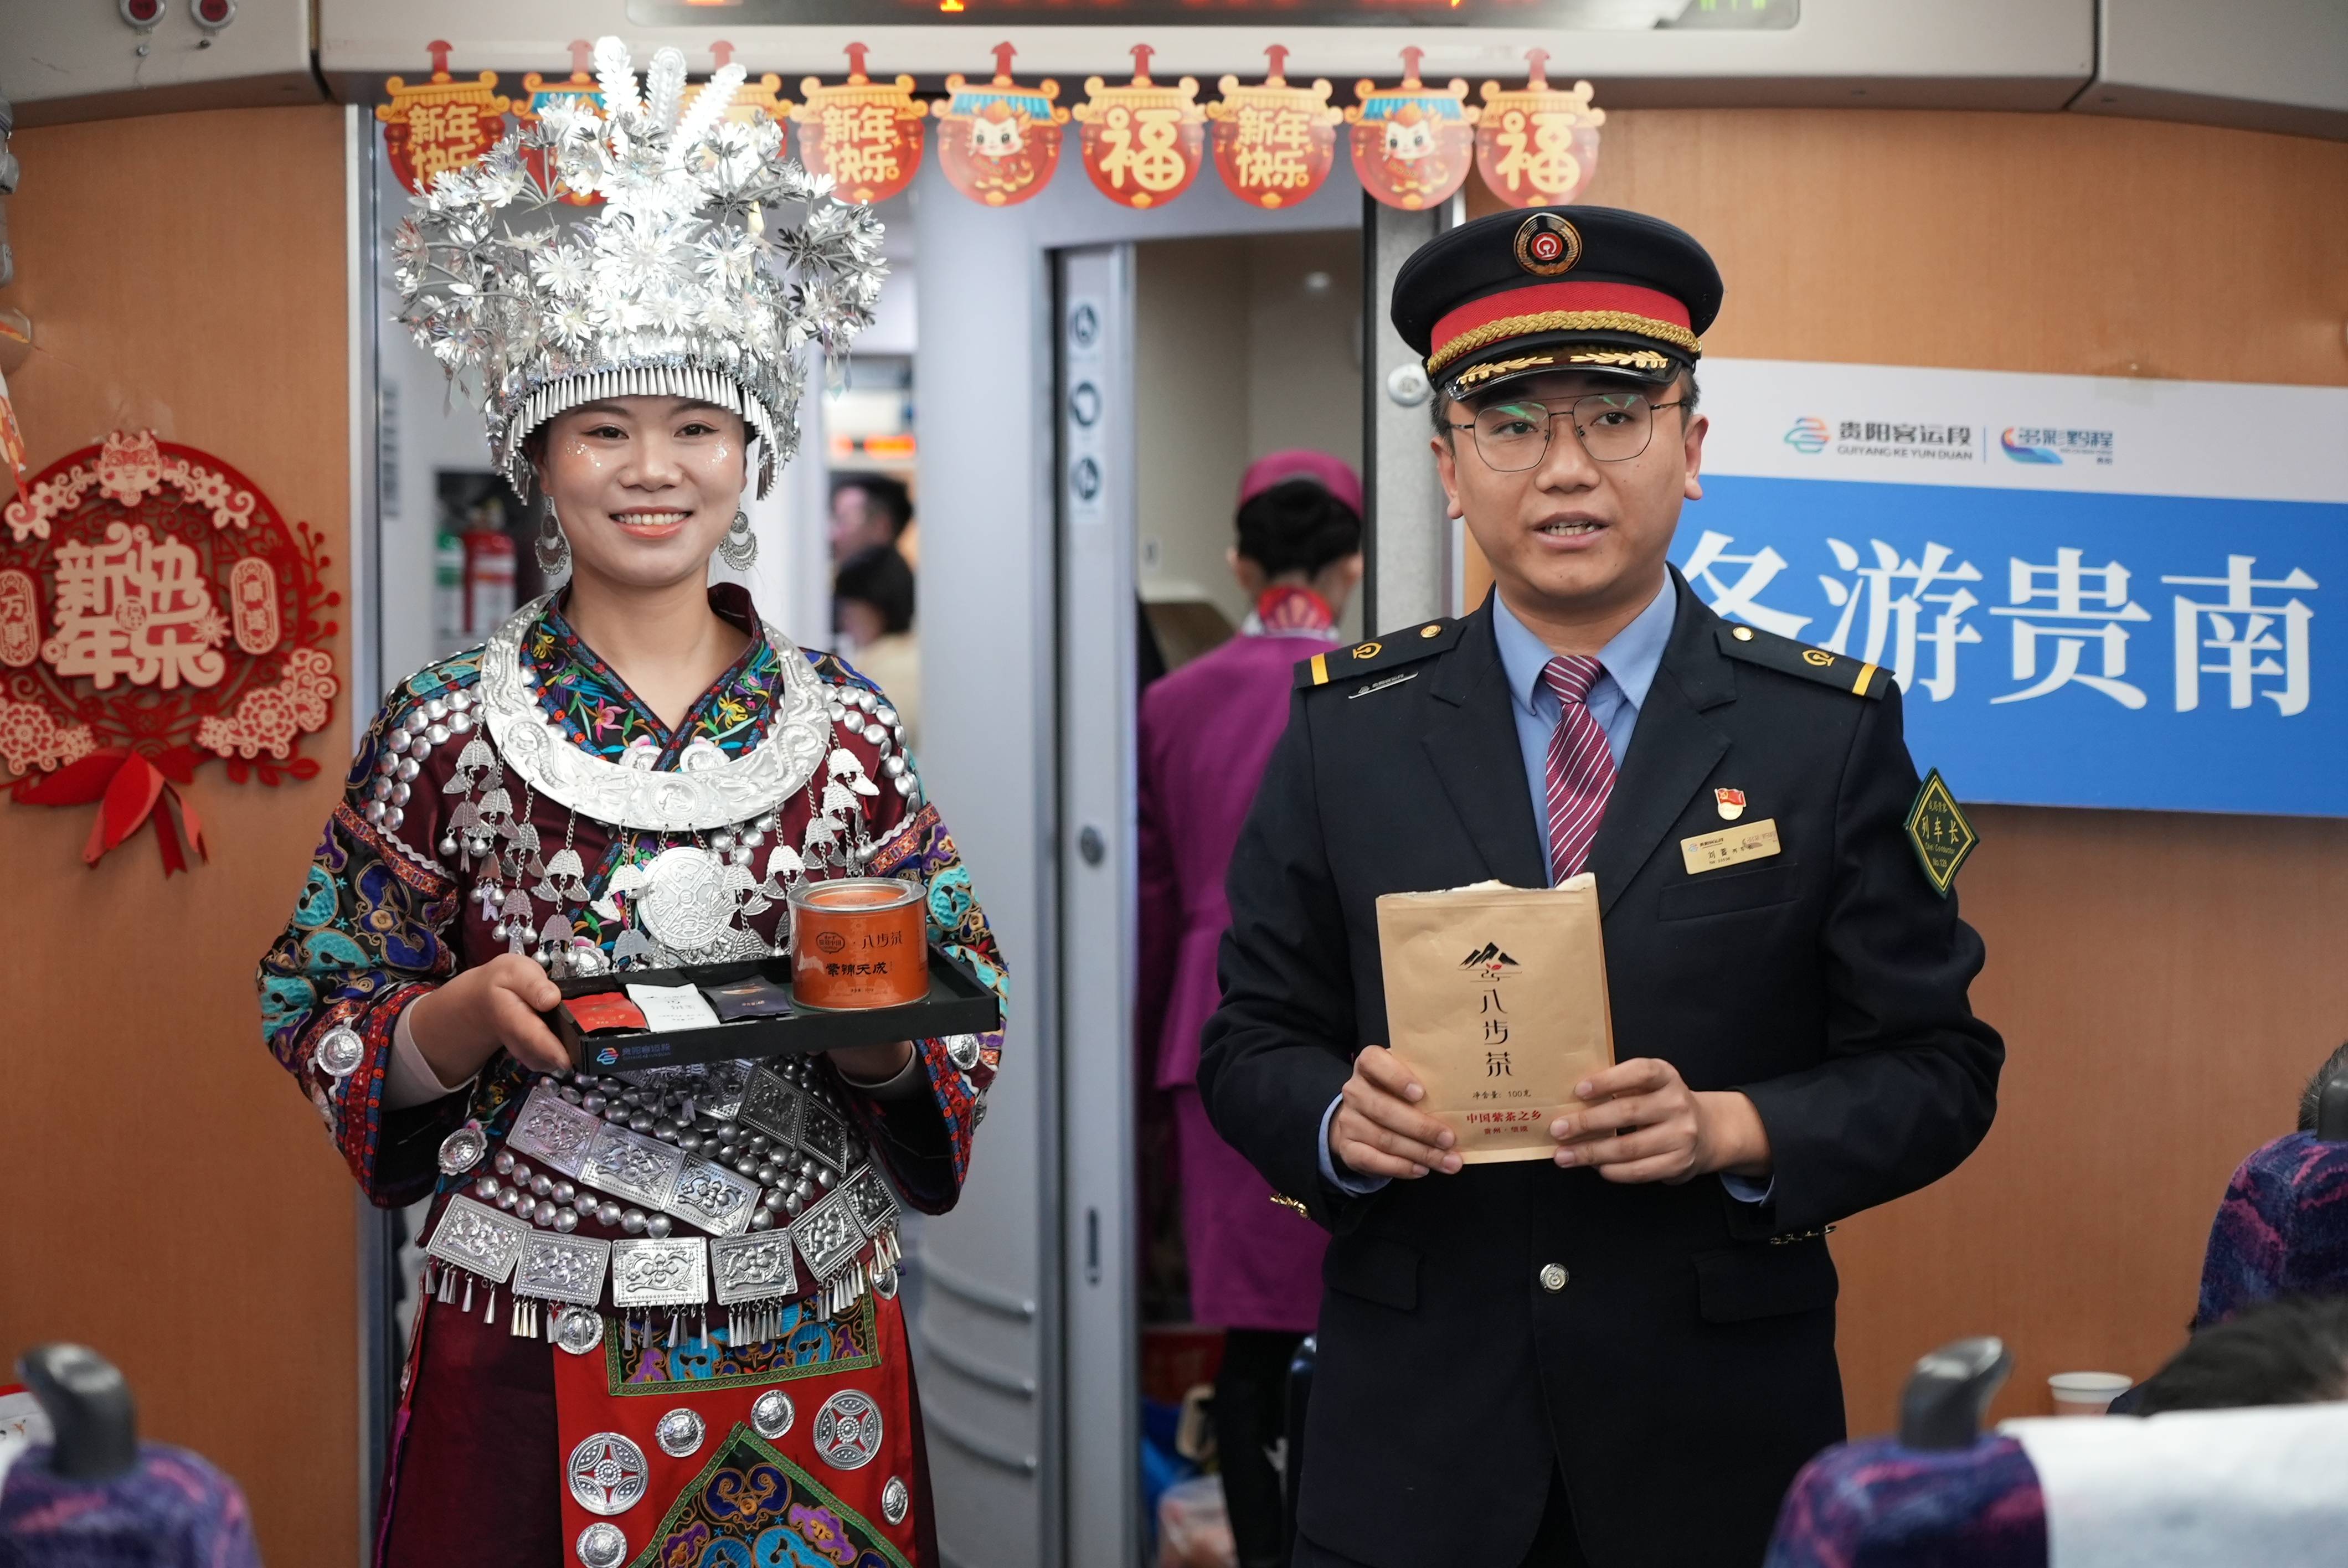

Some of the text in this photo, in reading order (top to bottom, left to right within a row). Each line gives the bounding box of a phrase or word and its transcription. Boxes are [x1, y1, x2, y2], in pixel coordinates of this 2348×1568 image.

[409, 105, 480, 143] 新年
[823, 106, 896, 145] 新年
[1238, 110, 1312, 147] 新年
[824, 144, 895, 183] 快乐
[1100, 107, 1186, 192] 福
[1235, 147, 1306, 188] 快乐
[1496, 112, 1579, 192] 福
[1839, 420, 1972, 446] 贵阳客运段
[1838, 446, 1973, 461] GUIYANG KE YUN DUAN
[1922, 814, 1959, 844] 列车长
[1480, 989, 1512, 1077] 八步茶
[1466, 1110, 1542, 1124] 中国紫茶之乡
